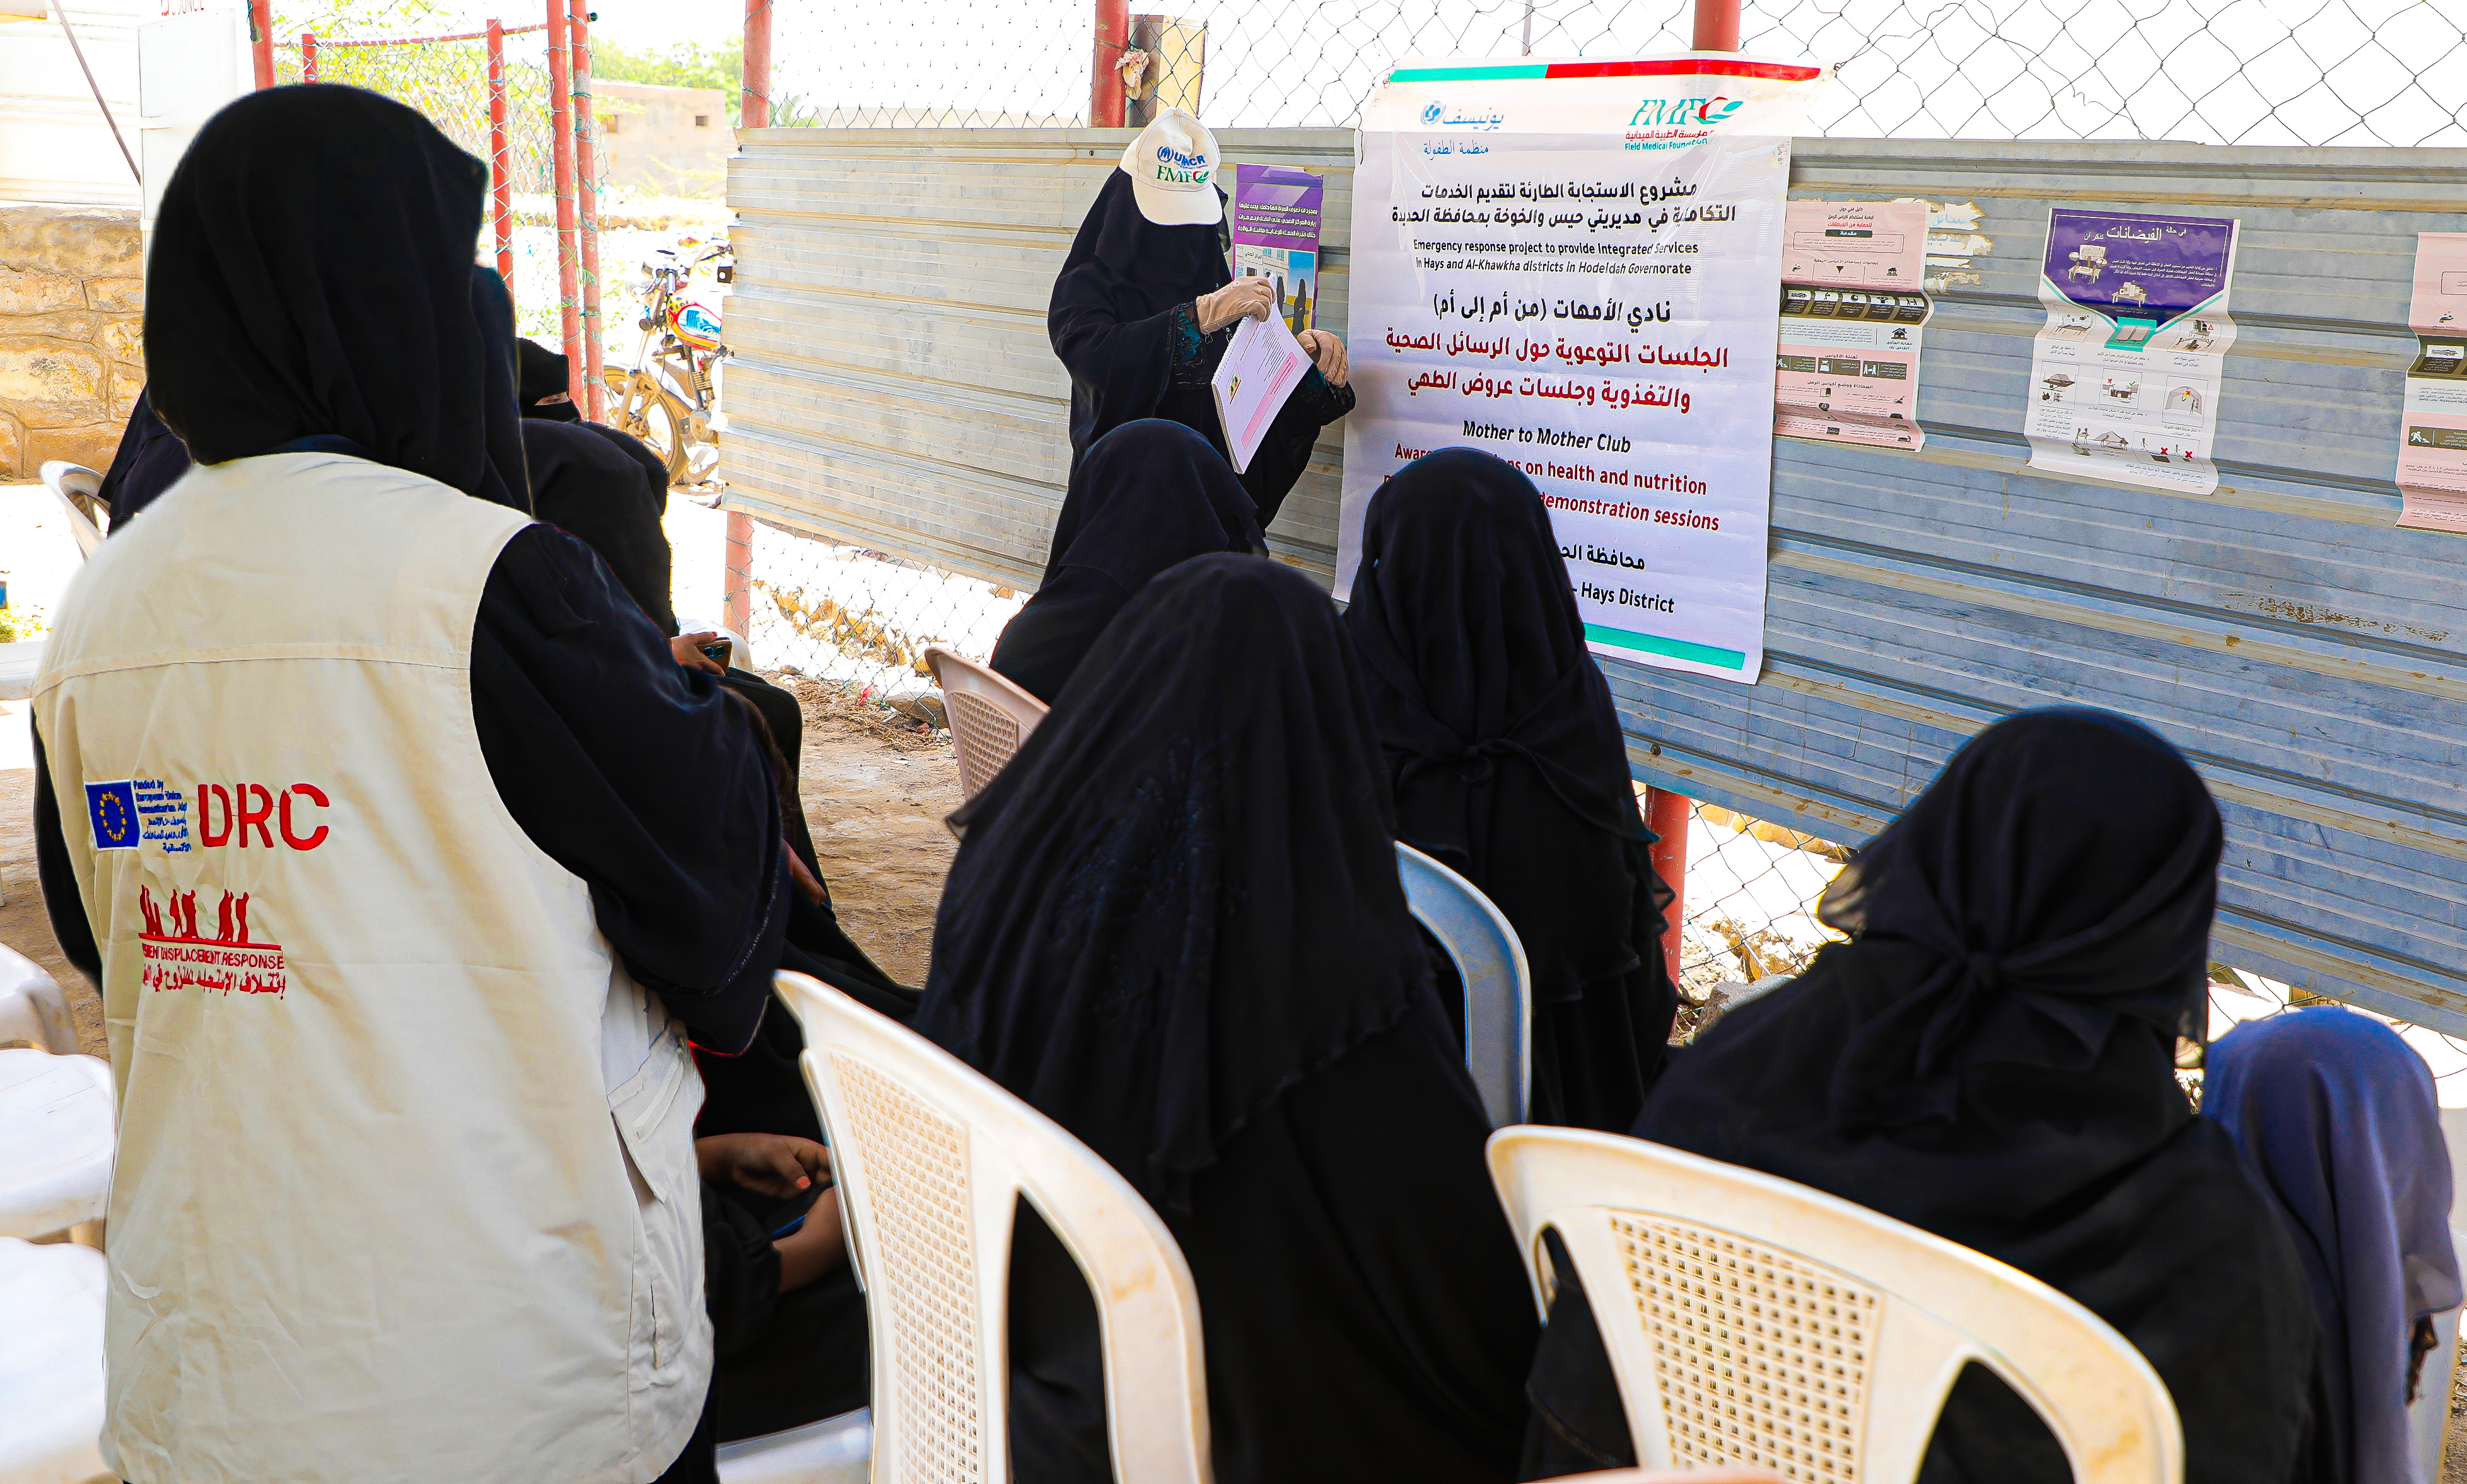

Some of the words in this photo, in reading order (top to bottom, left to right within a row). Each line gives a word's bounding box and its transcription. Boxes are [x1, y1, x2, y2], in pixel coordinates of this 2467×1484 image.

[1443, 107, 1504, 131] يونيسف
[1459, 139, 1488, 154] منظمة
[1625, 142, 1640, 151] Field
[1642, 142, 1667, 150] Medical
[1626, 130, 1654, 141] الميدانية
[1655, 129, 1678, 141] الطبية
[1424, 139, 1454, 160] الطفولة
[1421, 183, 1472, 199] الخدمات
[1476, 183, 1515, 204] لتقديم
[1519, 181, 1564, 202] الطارئة
[1568, 182, 1635, 202] الاستجابة
[1640, 177, 1697, 206] مشروع
[1392, 206, 1430, 226] الحديدة
[1433, 207, 1490, 228] بمحافظة
[1494, 207, 1544, 228] والخوخة
[1549, 212, 1583, 229] حيس
[1587, 208, 1642, 233] مديريتي
[1648, 208, 1669, 233] في
[1672, 205, 1736, 227] التكاملية
[2106, 225, 2162, 244] الفيضانات
[2178, 227, 2186, 236] في
[1413, 239, 1462, 253] Emergency
[1465, 242, 1507, 253] response
[1508, 241, 1543, 255] project
[1546, 243, 1555, 253] to
[1558, 242, 1595, 255] provide
[1653, 241, 1698, 253] Services
[1424, 257, 1444, 270] Hays
[1447, 258, 1464, 270] and
[1466, 258, 1520, 272] Al-Khawkha
[1523, 260, 1563, 272] districts
[1578, 262, 1626, 274] Hodeidah
[1628, 262, 1691, 274] Governorate
[1433, 289, 1454, 321] أم)
[1461, 295, 1484, 323] إلى
[1489, 291, 1508, 323] أم
[1515, 298, 1547, 322] (من
[1554, 298, 1623, 322] الأمهات
[1627, 301, 1671, 333] نادي
[1386, 327, 1441, 354] الصحية
[1447, 330, 1510, 359] الرسائل
[1516, 337, 1550, 362] حول
[1556, 337, 1630, 367] التوعوية
[1638, 344, 1728, 374] الجلسات
[1408, 369, 1457, 397] الطهي
[1462, 372, 1513, 398] عروض
[1520, 378, 1595, 406] وجلسات
[1602, 380, 1690, 414] والتغذوية
[1462, 420, 1515, 441] Mother
[1519, 427, 1533, 443] to
[1536, 427, 1593, 449] Mother
[1597, 433, 1631, 453] Club
[1525, 463, 1543, 476] on
[1548, 461, 1595, 482] health
[1599, 468, 1628, 486] and
[1634, 473, 1706, 496] nutrition
[1653, 509, 1719, 531] sessions
[1587, 544, 1645, 570] محافظة
[1582, 582, 1614, 605] Hays
[1619, 588, 1674, 613] District
[197, 783, 329, 850] DRC
[222, 951, 284, 969] RESPONSE
